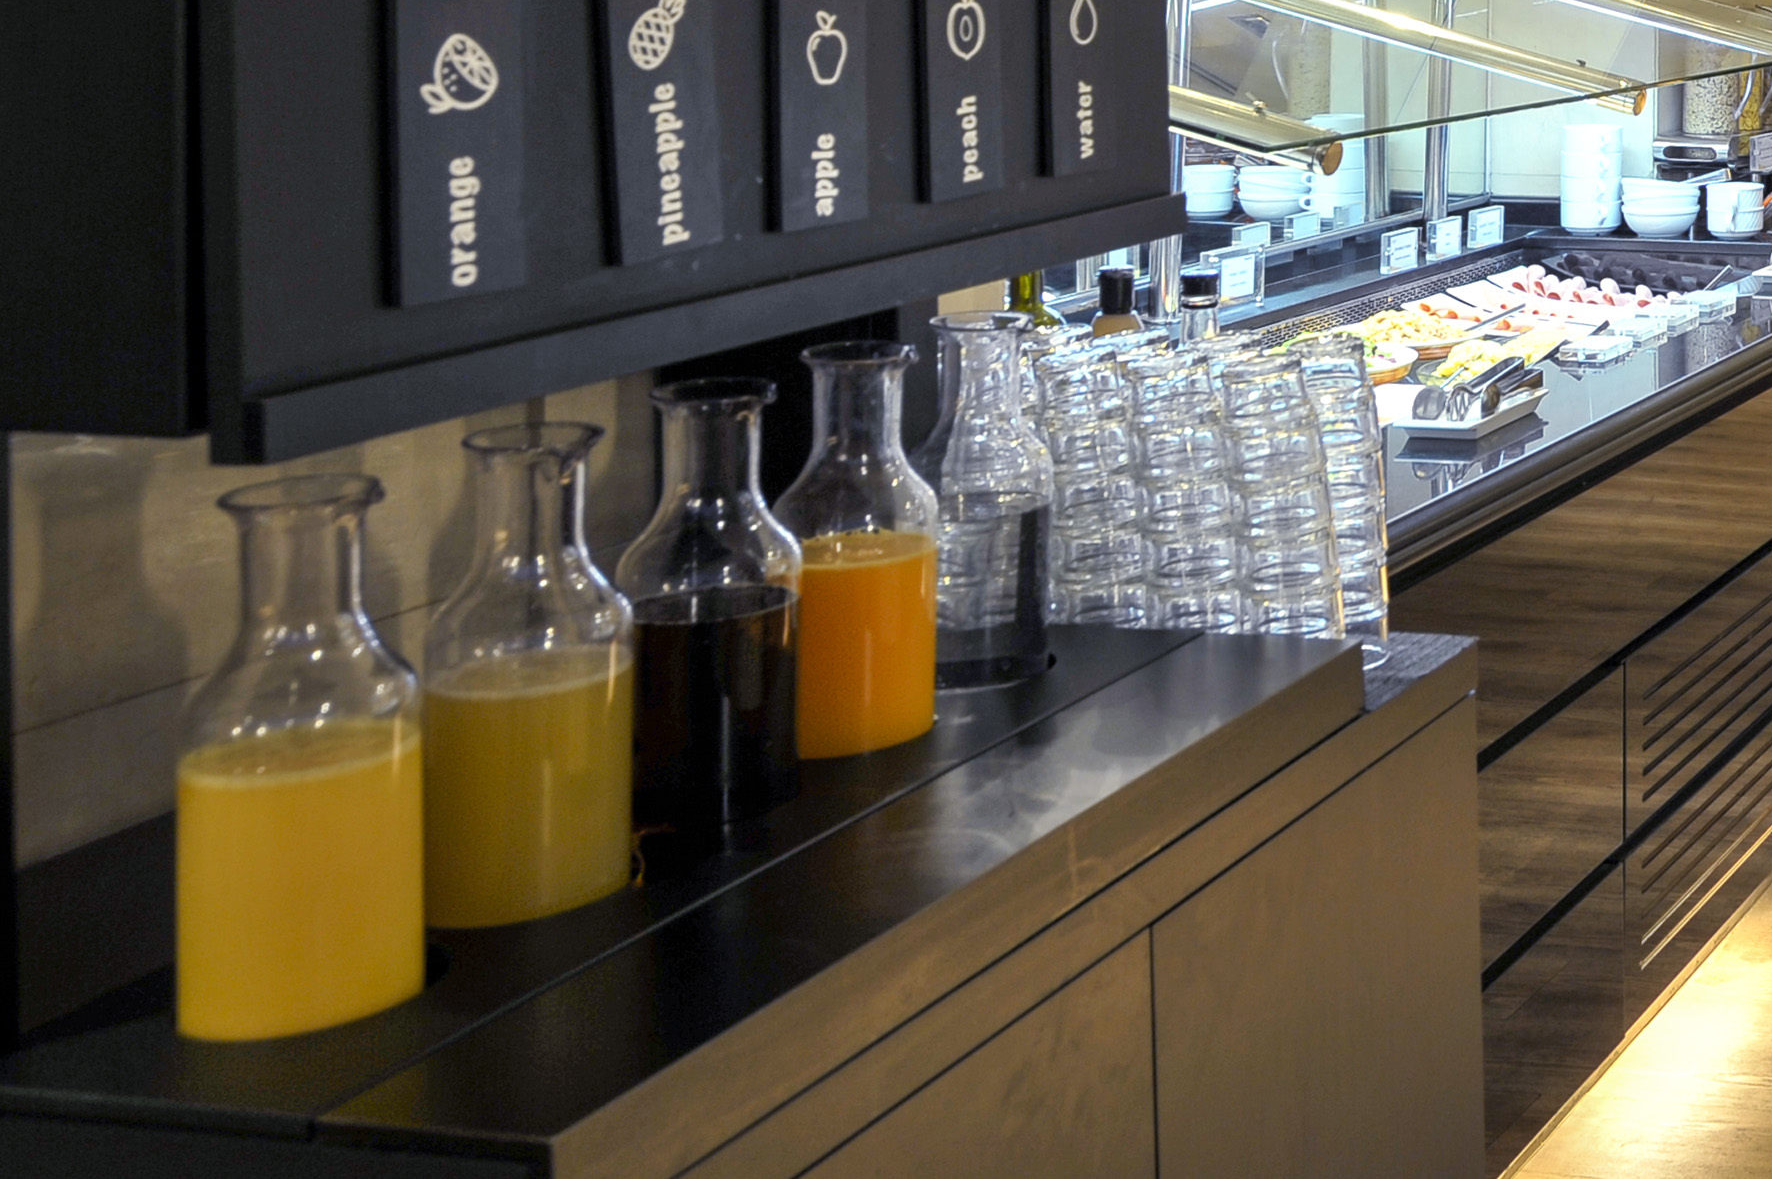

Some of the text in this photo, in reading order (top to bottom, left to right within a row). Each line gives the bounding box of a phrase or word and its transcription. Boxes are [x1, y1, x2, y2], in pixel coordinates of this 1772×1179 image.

[647, 81, 692, 247] pineapple
[955, 94, 983, 184] peach
[1075, 80, 1095, 160] water
[810, 132, 841, 218] apple
[448, 155, 482, 288] orange
